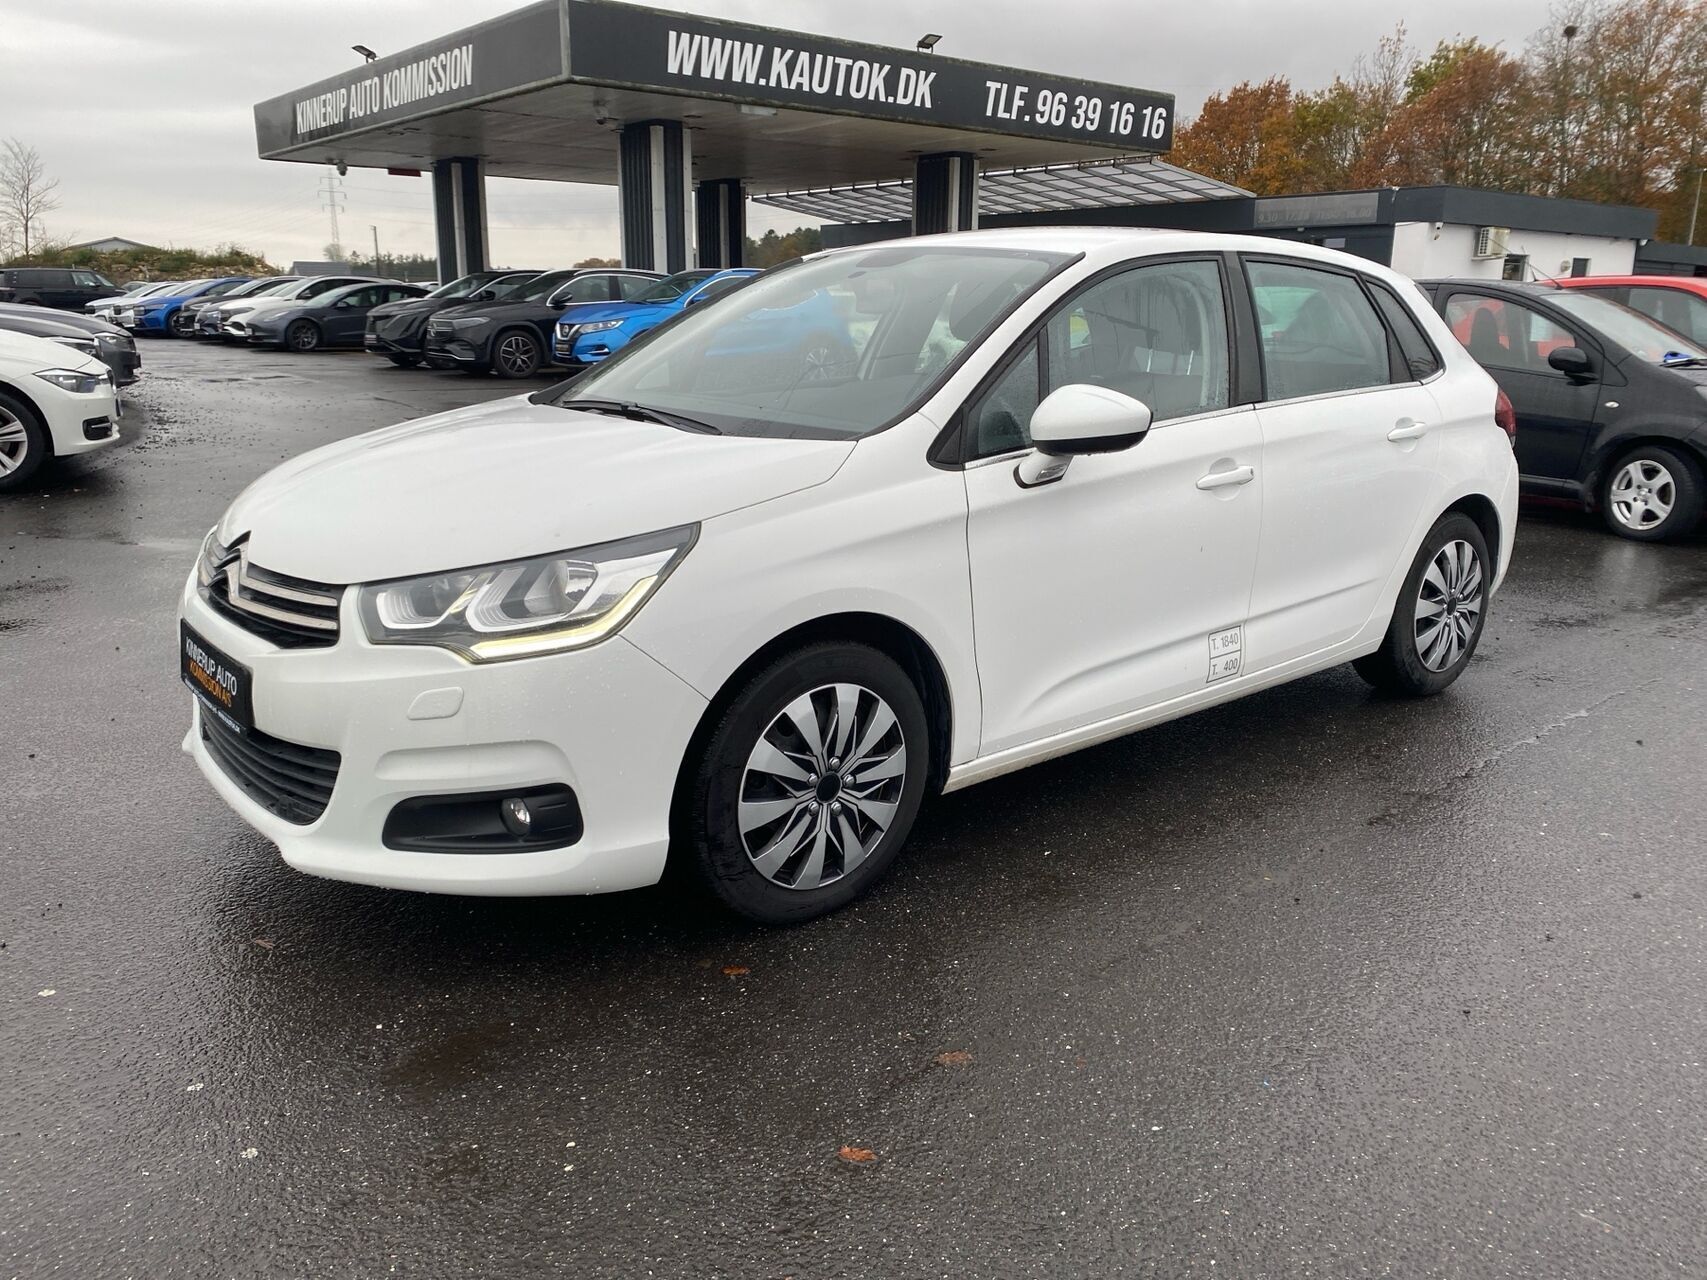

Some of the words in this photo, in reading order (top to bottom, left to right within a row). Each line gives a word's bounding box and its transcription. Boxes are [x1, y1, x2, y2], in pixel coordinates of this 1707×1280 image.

[296, 88, 347, 134] KINNERUP
[349, 77, 380, 119] AUTO
[383, 44, 473, 109] KOMMISSION
[667, 30, 937, 108] WWW.KAUTOK.DK
[985, 80, 1030, 122] TLF.
[1035, 89, 1068, 127] 96
[1071, 95, 1102, 131] 39
[1110, 101, 1135, 135] 16
[1142, 106, 1167, 140] 16
[1221, 632, 1239, 648] 1840
[216, 665, 237, 695] AUTO
[1223, 658, 1239, 671] 400
